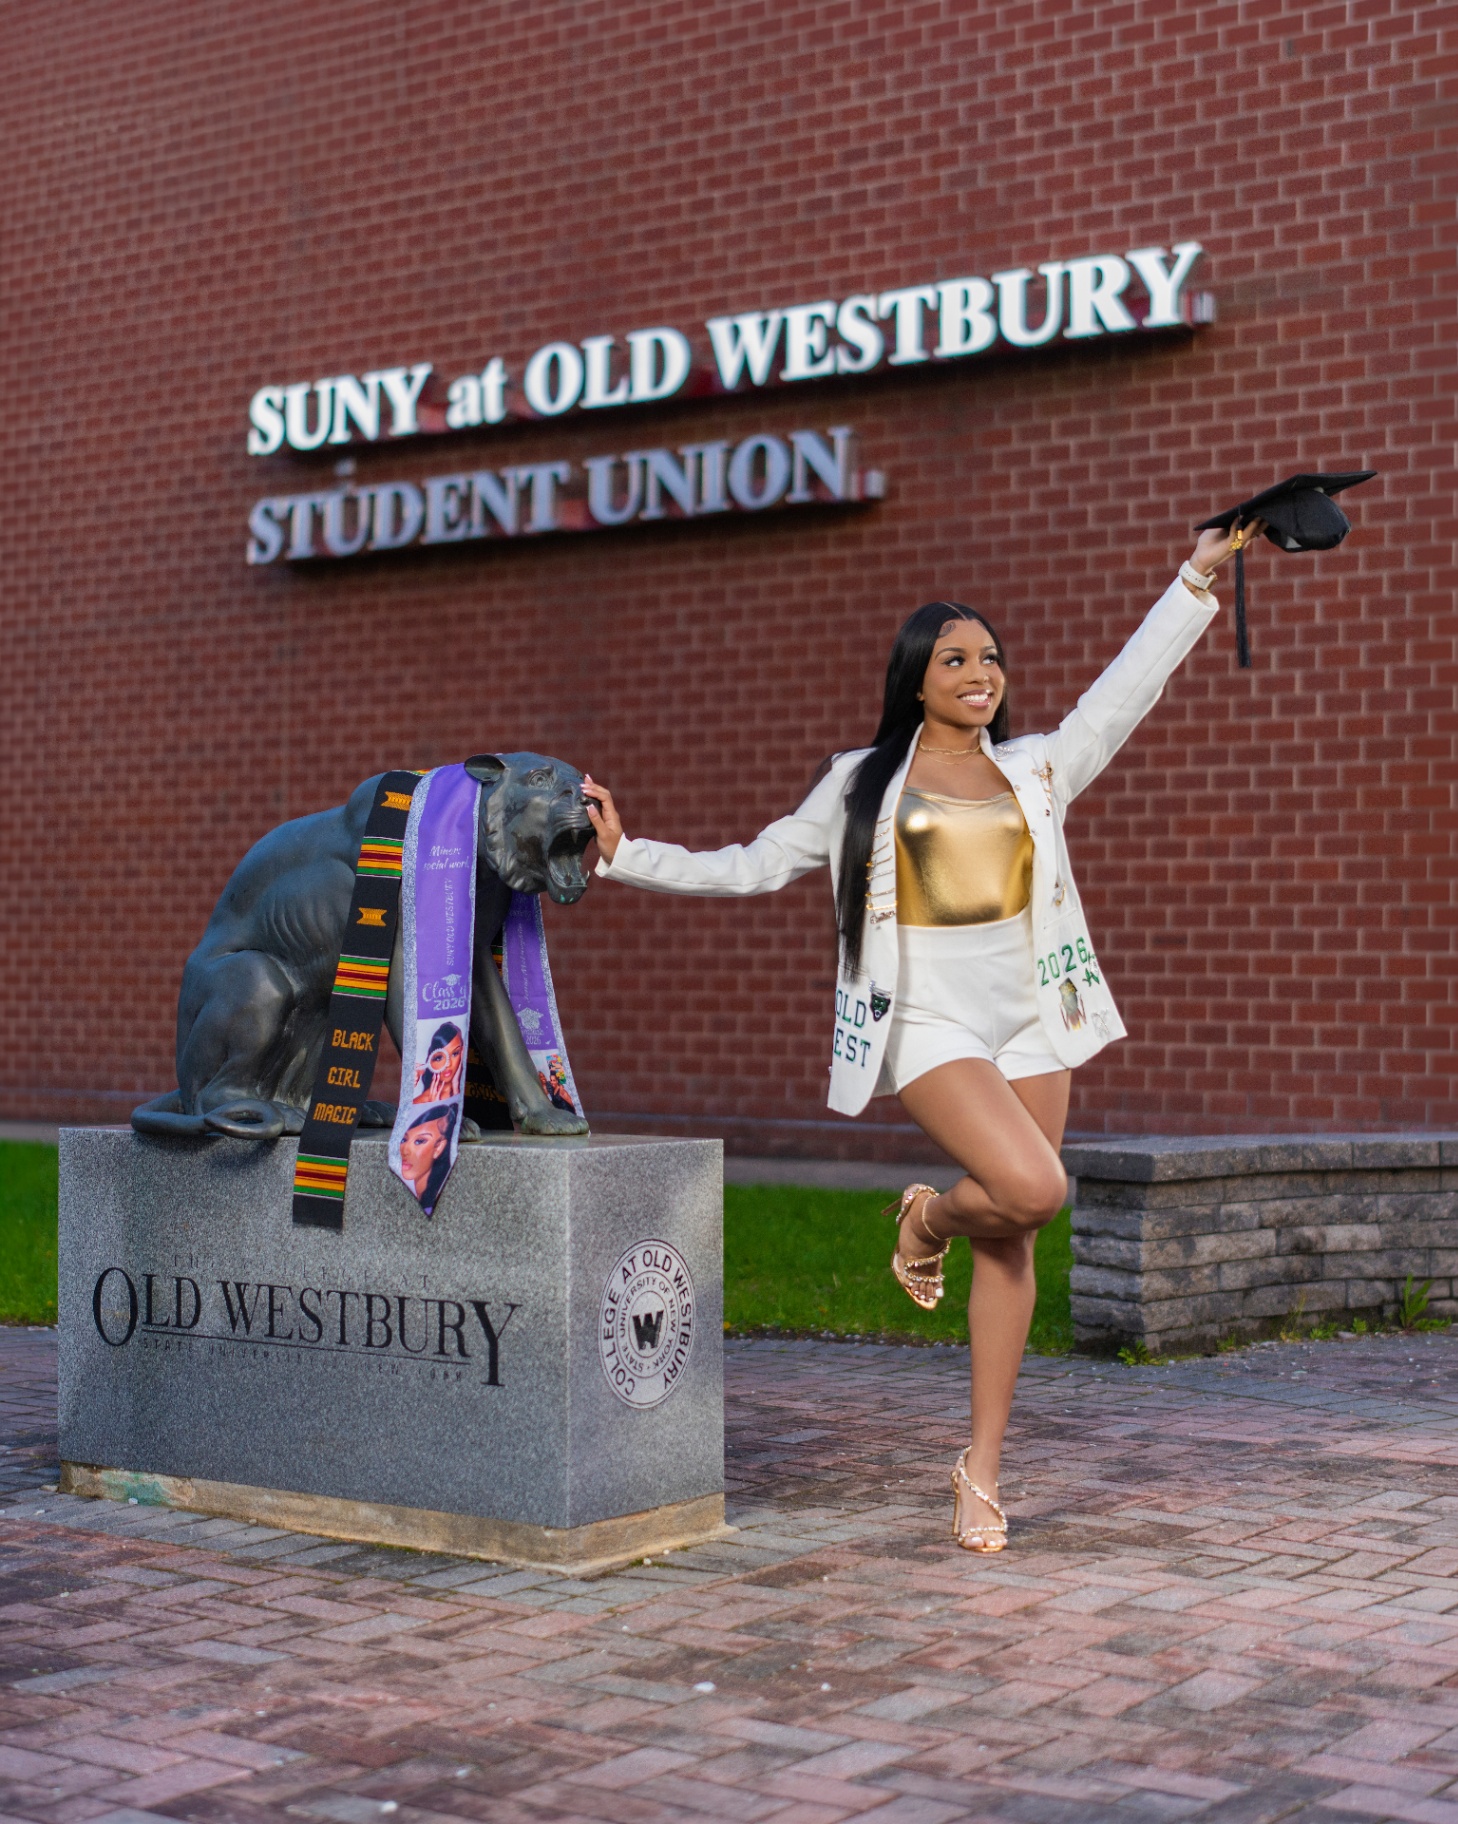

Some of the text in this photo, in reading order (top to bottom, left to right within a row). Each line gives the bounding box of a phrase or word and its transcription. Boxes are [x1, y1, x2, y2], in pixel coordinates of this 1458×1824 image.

[247, 241, 1202, 456] SUNY at OLD WESTBURY
[246, 425, 853, 565] STUDENT UNION
[1037, 936, 1088, 987] 2026
[422, 981, 455, 1002] Class
[433, 997, 465, 1011] 2026
[835, 988, 867, 1028] OLD
[331, 1028, 375, 1051] BLACK
[834, 1028, 871, 1067] EST
[327, 1066, 361, 1089] GIRL
[313, 1102, 357, 1125] MAGIC
[658, 1281, 671, 1294] OF
[603, 1250, 692, 1396] COLLEGE AT OLD WESTBURY
[619, 1276, 657, 1338] UNIVERSITY
[668, 1299, 676, 1333] NEW
[93, 1267, 523, 1386] OLD WESTBURY
[652, 1338, 674, 1370] YORK
